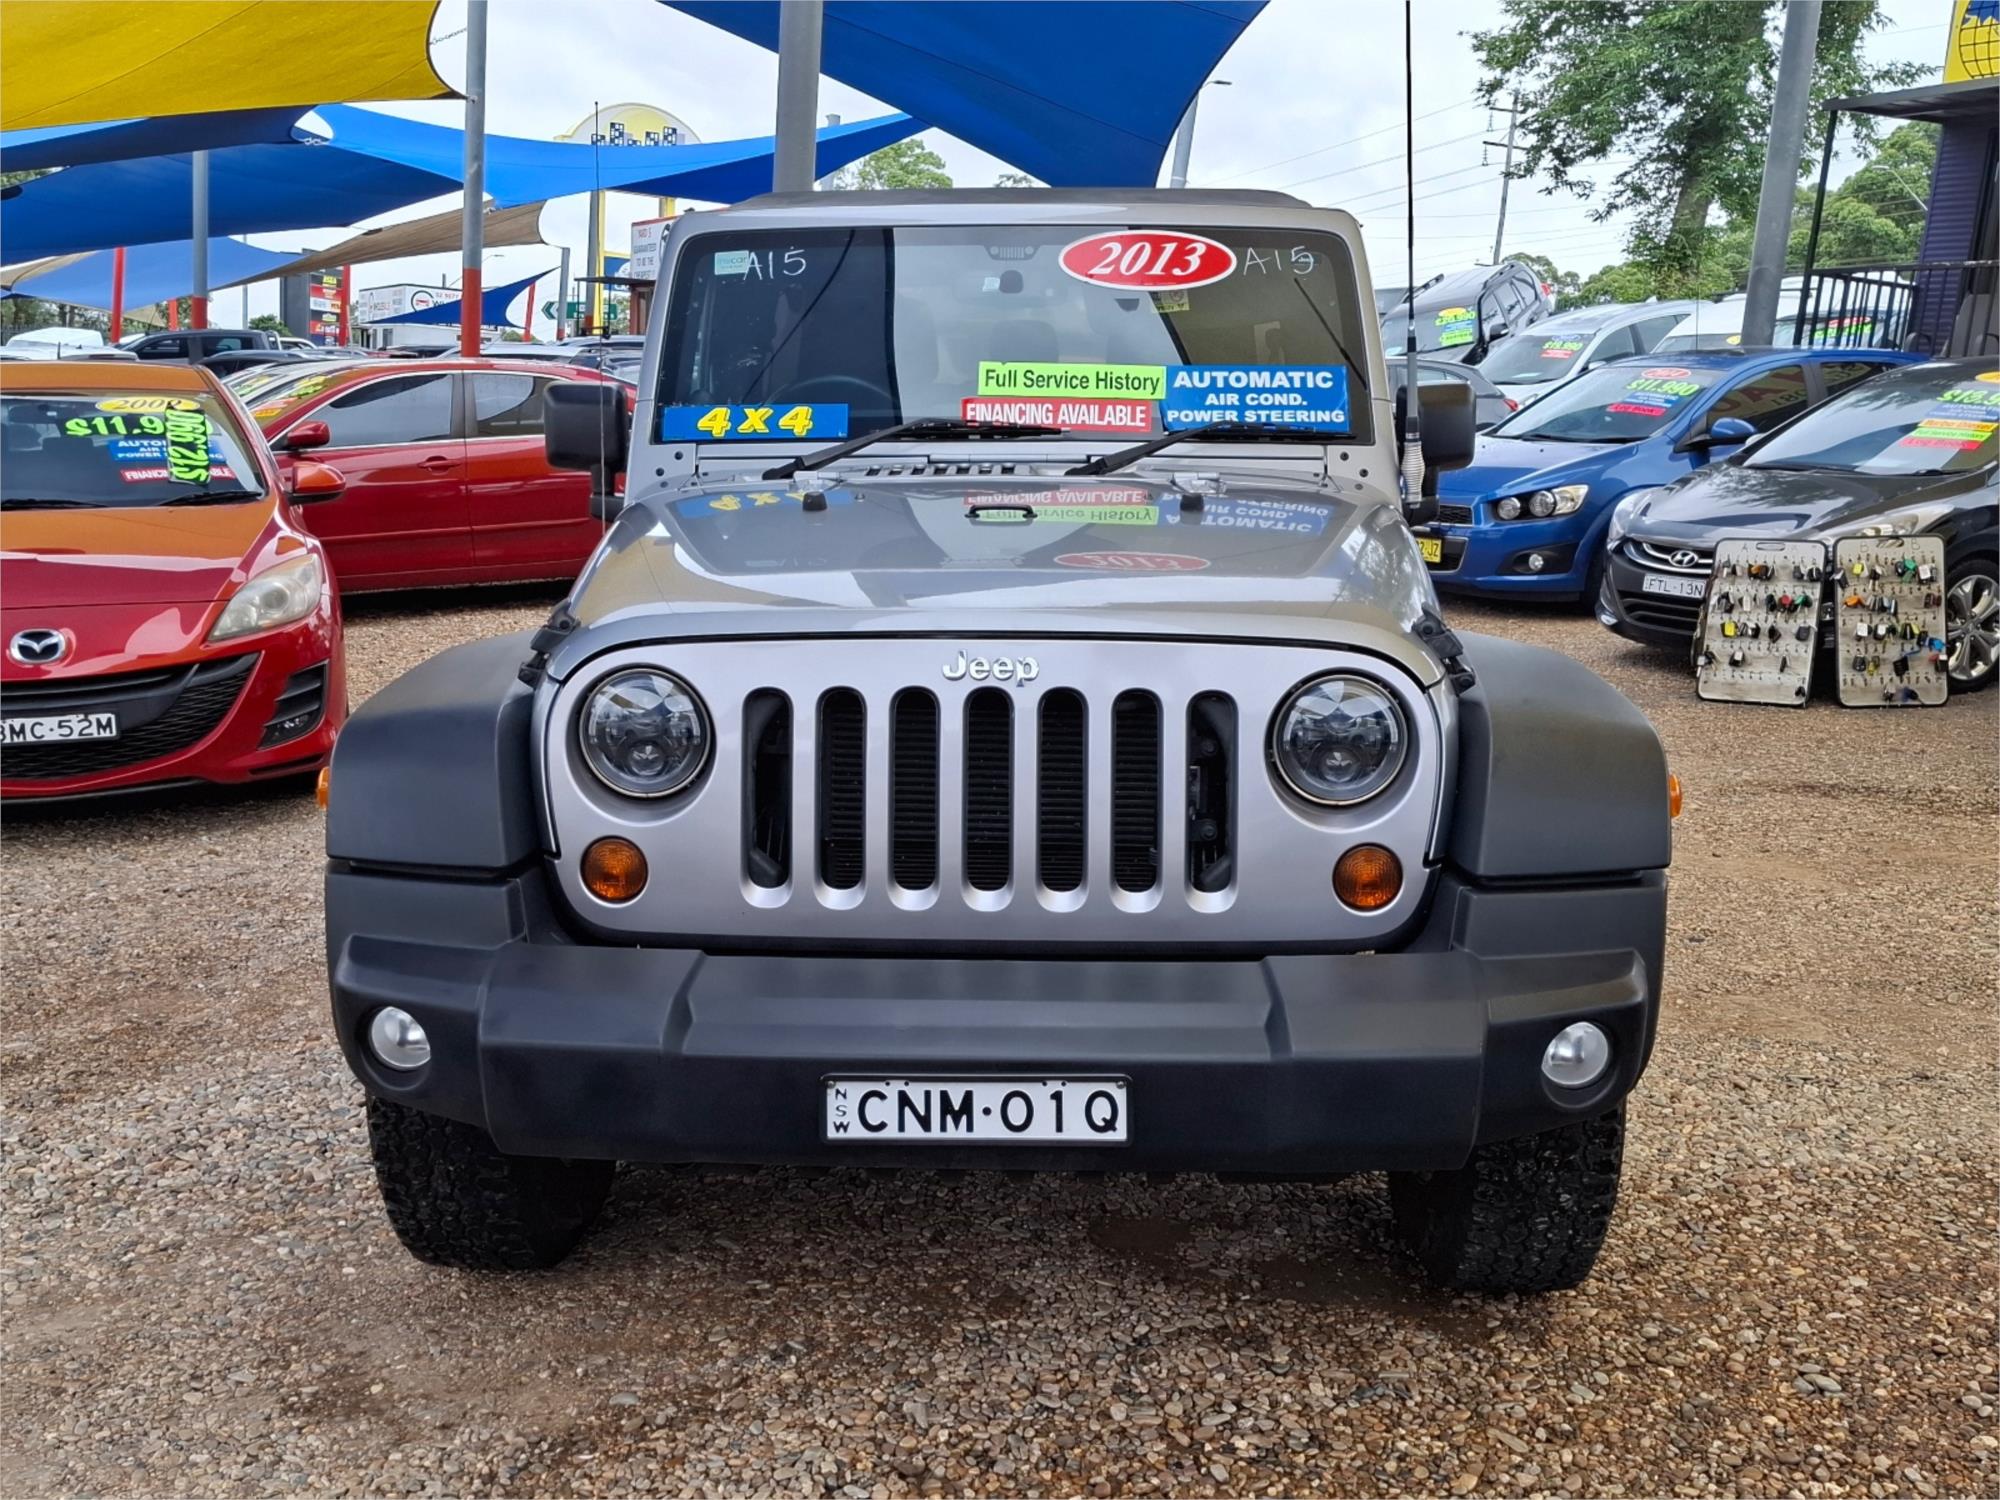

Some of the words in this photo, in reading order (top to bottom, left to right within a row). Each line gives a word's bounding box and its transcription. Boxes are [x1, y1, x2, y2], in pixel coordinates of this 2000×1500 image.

[1087, 241, 1207, 277] 2013
[984, 369, 1017, 389] Full
[1023, 371, 1090, 390] Service
[1095, 371, 1162, 395] History
[1173, 370, 1334, 389] AUTOMATIC
[1205, 393, 1242, 406] AIR
[1244, 393, 1309, 407] COND.
[966, 402, 1053, 425] FINANCING
[1058, 403, 1147, 427] AVAILABLE
[1167, 410, 1239, 423] POWER
[1243, 409, 1346, 425] STEERING
[942, 649, 1040, 688] Jeep
